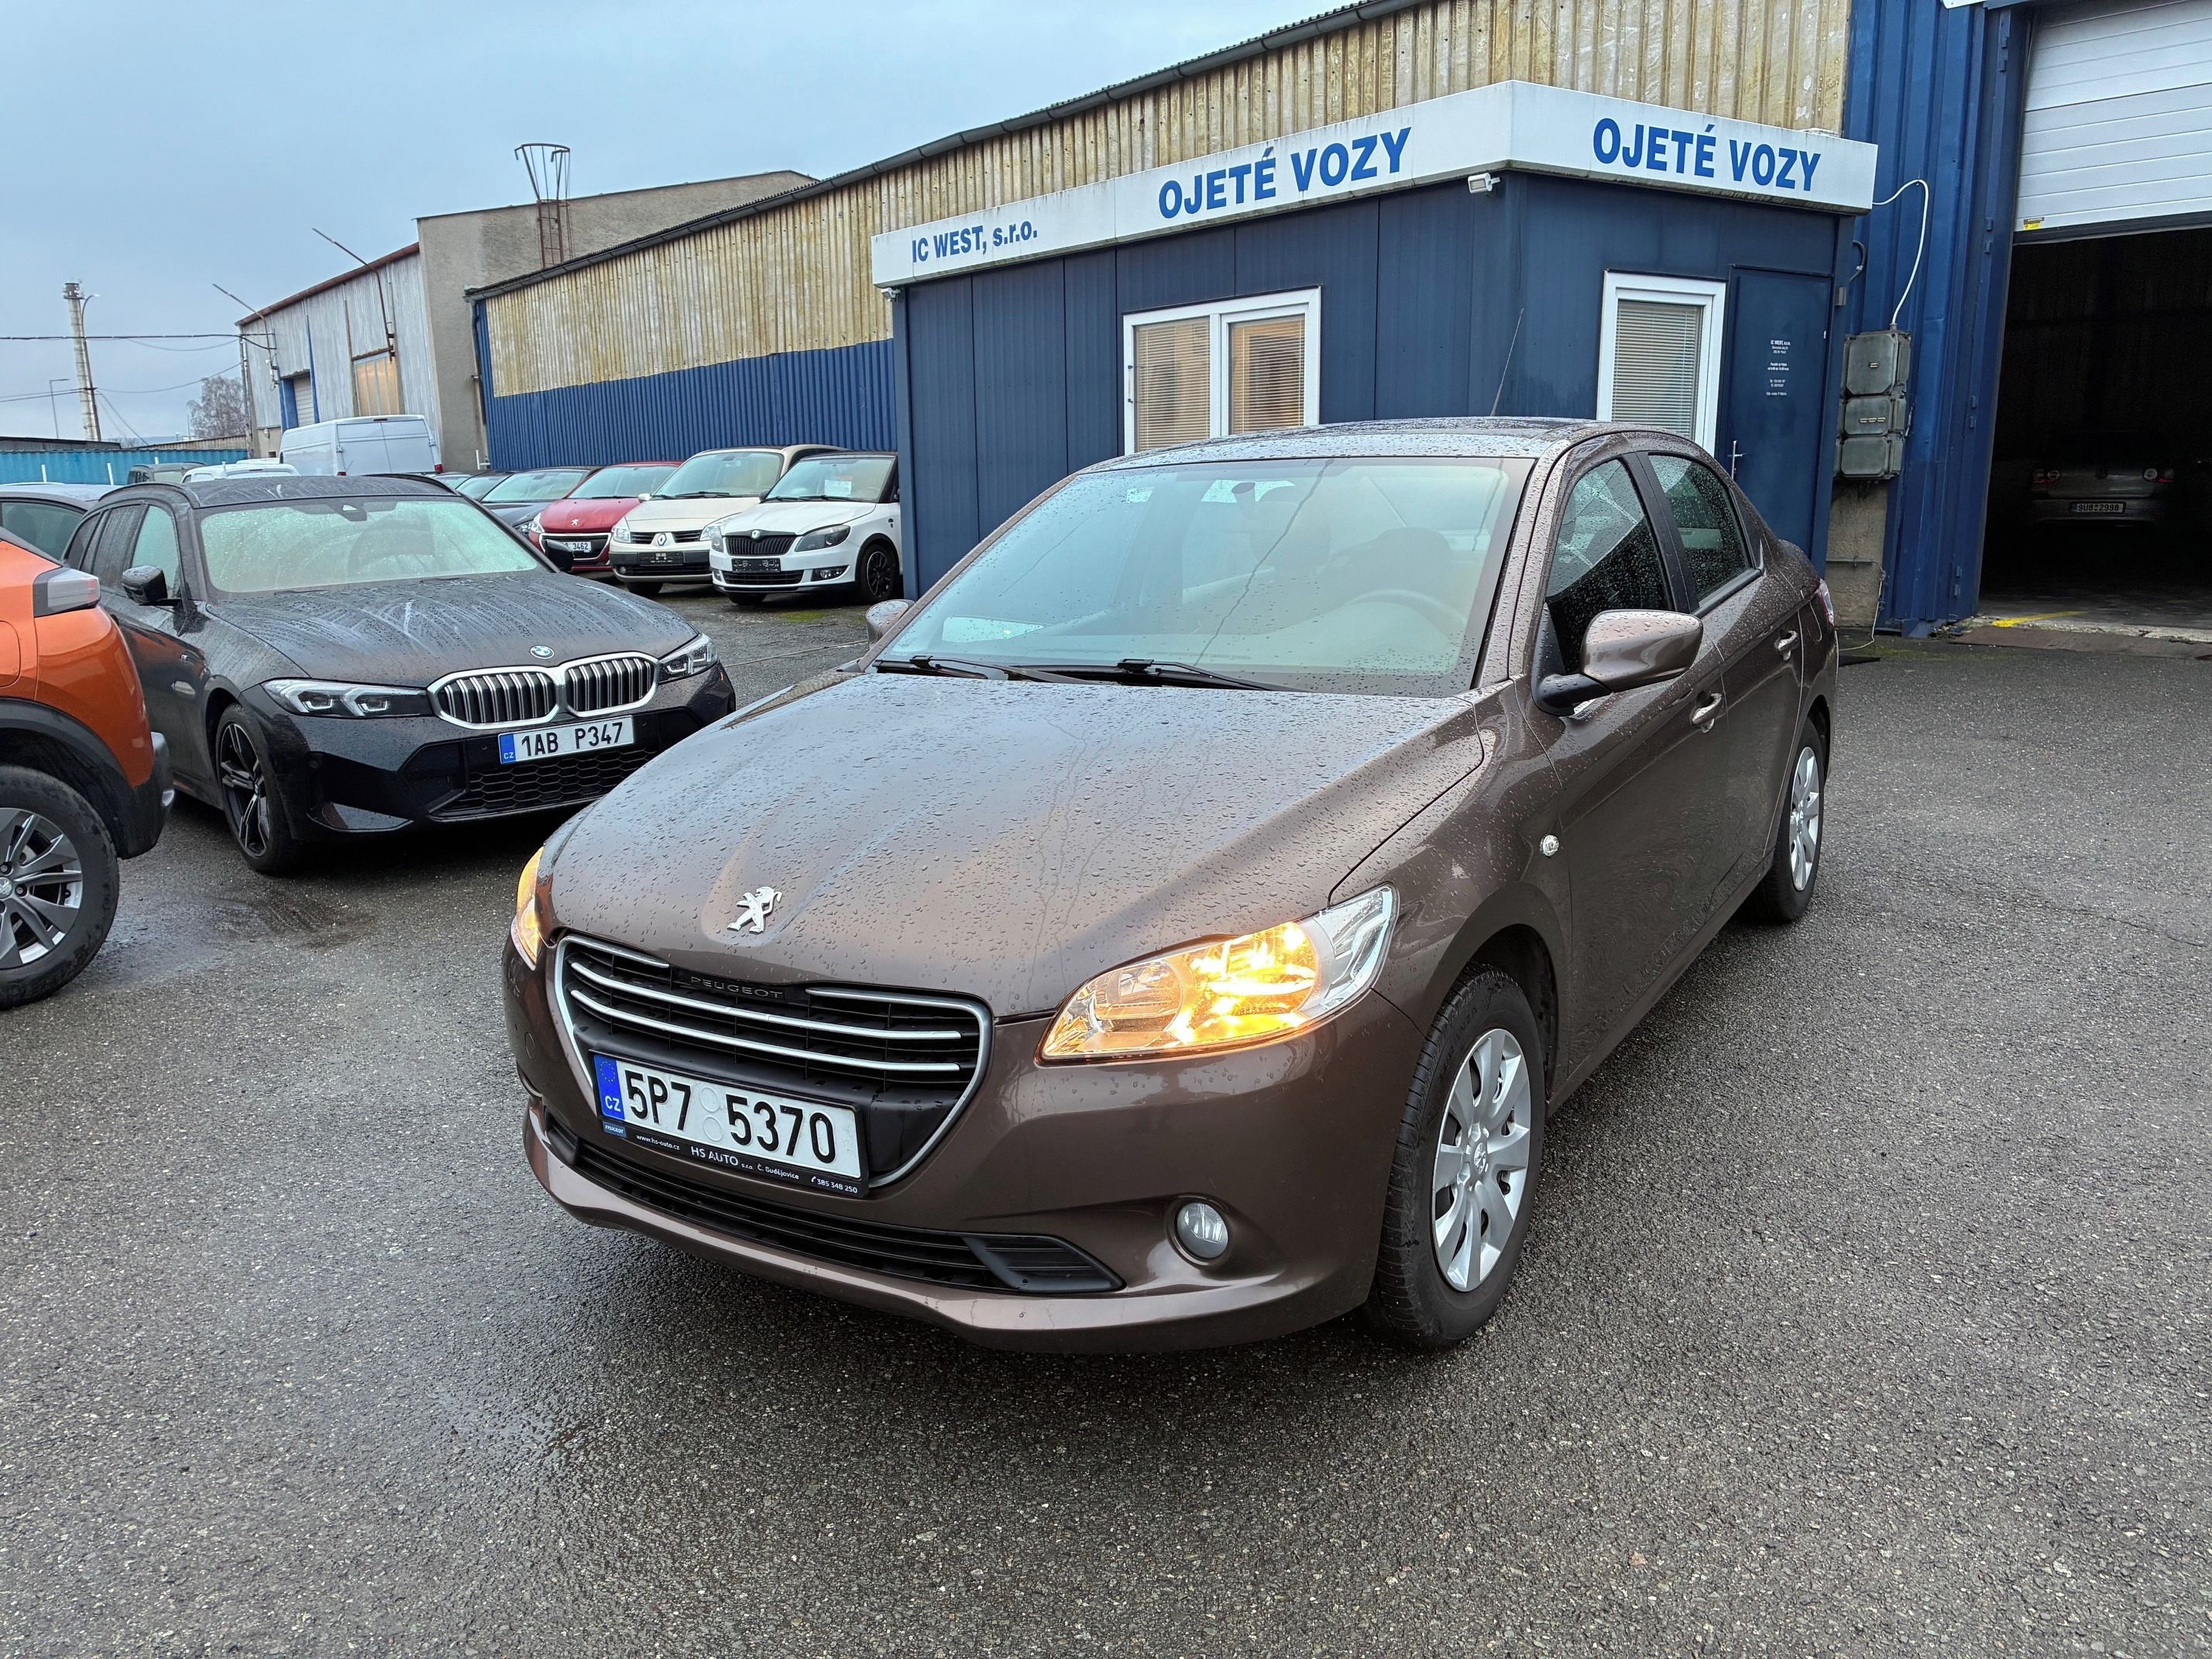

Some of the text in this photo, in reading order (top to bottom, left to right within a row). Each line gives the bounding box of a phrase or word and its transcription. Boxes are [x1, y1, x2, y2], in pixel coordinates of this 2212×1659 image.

[1593, 117, 1822, 191] OJETÉ VOZY
[1159, 126, 1412, 219] OJETÉ VOZY
[912, 221, 1038, 263] IC WEST, s.r.o.
[503, 751, 514, 760] CZ
[521, 721, 623, 757] 1AB P347
[690, 976, 783, 999] PEUGEOT
[604, 1095, 621, 1112] CZ
[624, 1069, 836, 1164] 5P7 5370
[636, 1134, 681, 1151] www.hs-auto.cz
[691, 1146, 706, 1159] HS
[708, 1151, 739, 1167] AUTO
[764, 1166, 799, 1180] Budějovice
[816, 1178, 858, 1194] 385 348 250
